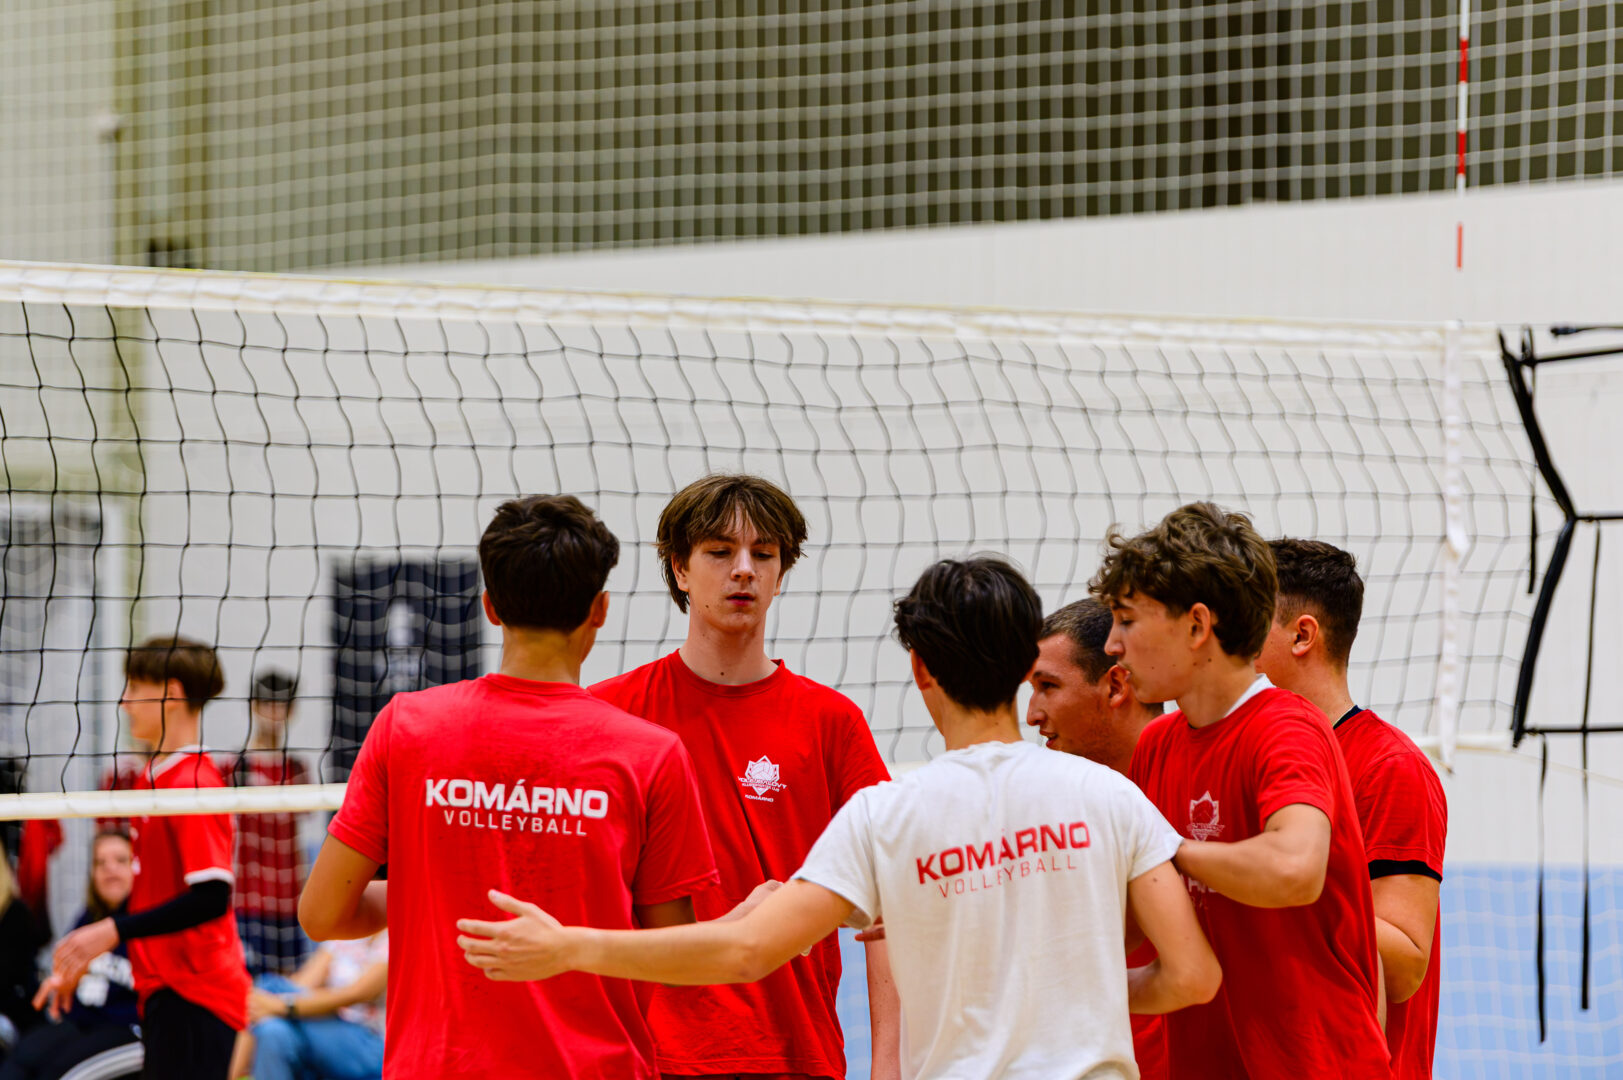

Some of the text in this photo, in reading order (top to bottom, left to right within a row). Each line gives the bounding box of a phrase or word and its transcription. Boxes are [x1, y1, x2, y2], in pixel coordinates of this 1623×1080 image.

[425, 779, 609, 819] KOMÁRNO
[444, 810, 587, 836] VOLLEYBALL
[916, 821, 1091, 885] KOMÁRNO
[938, 855, 1077, 898] VOLLEYBALL
